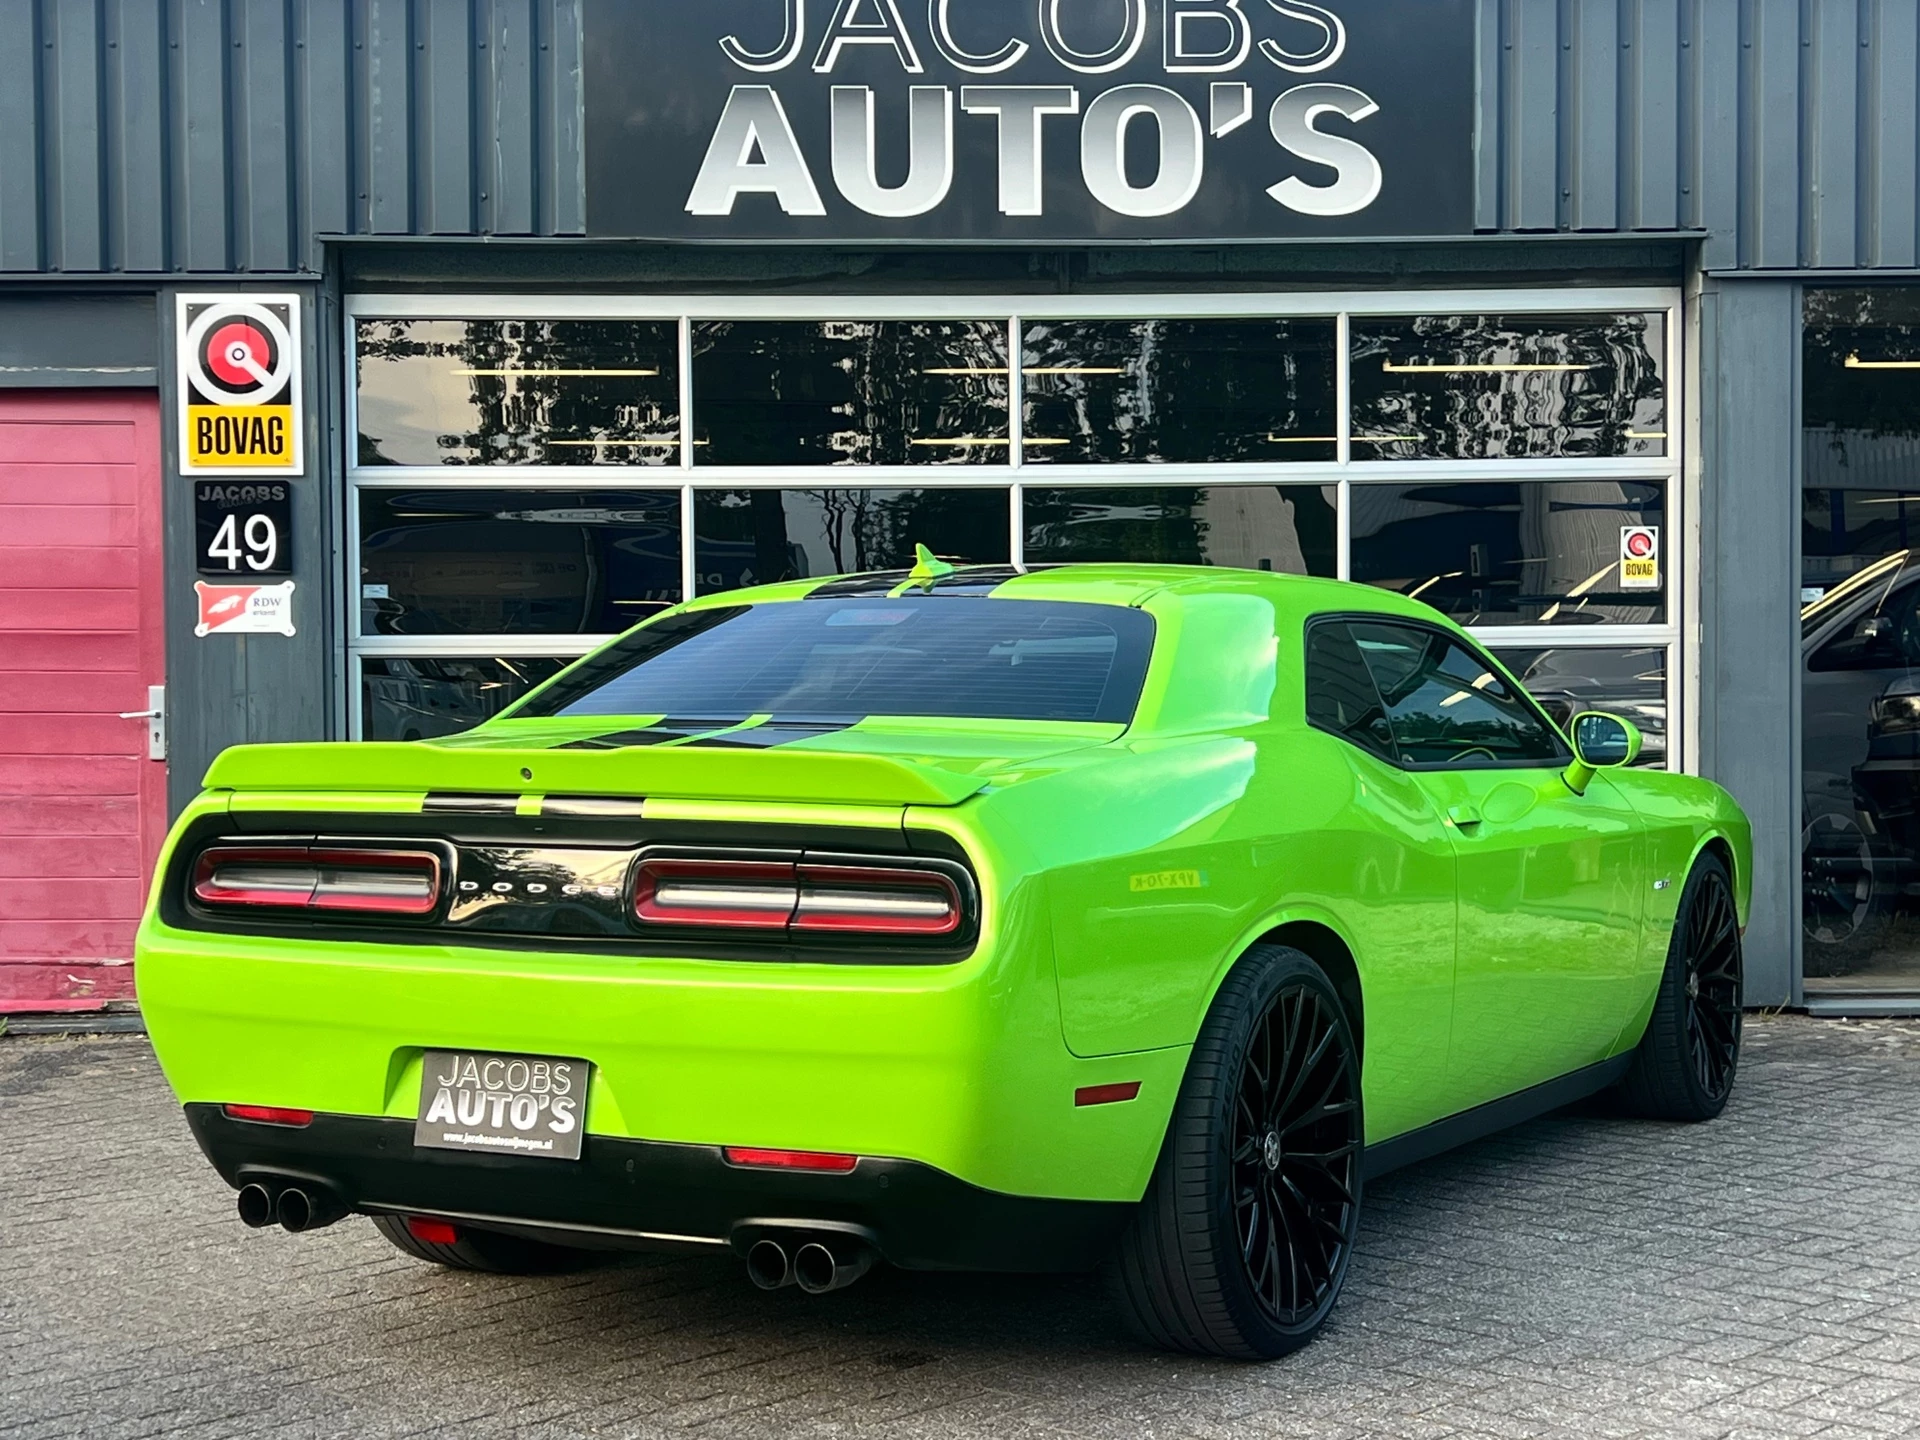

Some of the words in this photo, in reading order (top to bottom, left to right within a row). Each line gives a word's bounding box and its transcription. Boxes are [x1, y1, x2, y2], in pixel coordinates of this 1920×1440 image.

[718, 0, 1347, 74] JACOBS
[684, 83, 1383, 218] AUTO'S
[197, 415, 284, 456] BOVAG
[198, 485, 285, 501] JACOBS
[207, 513, 278, 571] 49
[1625, 563, 1653, 576] BOVAG
[252, 598, 283, 607] RDW
[459, 880, 618, 896] DODGE
[437, 1055, 572, 1096] JACOBS
[425, 1087, 577, 1134] AUTO'S
